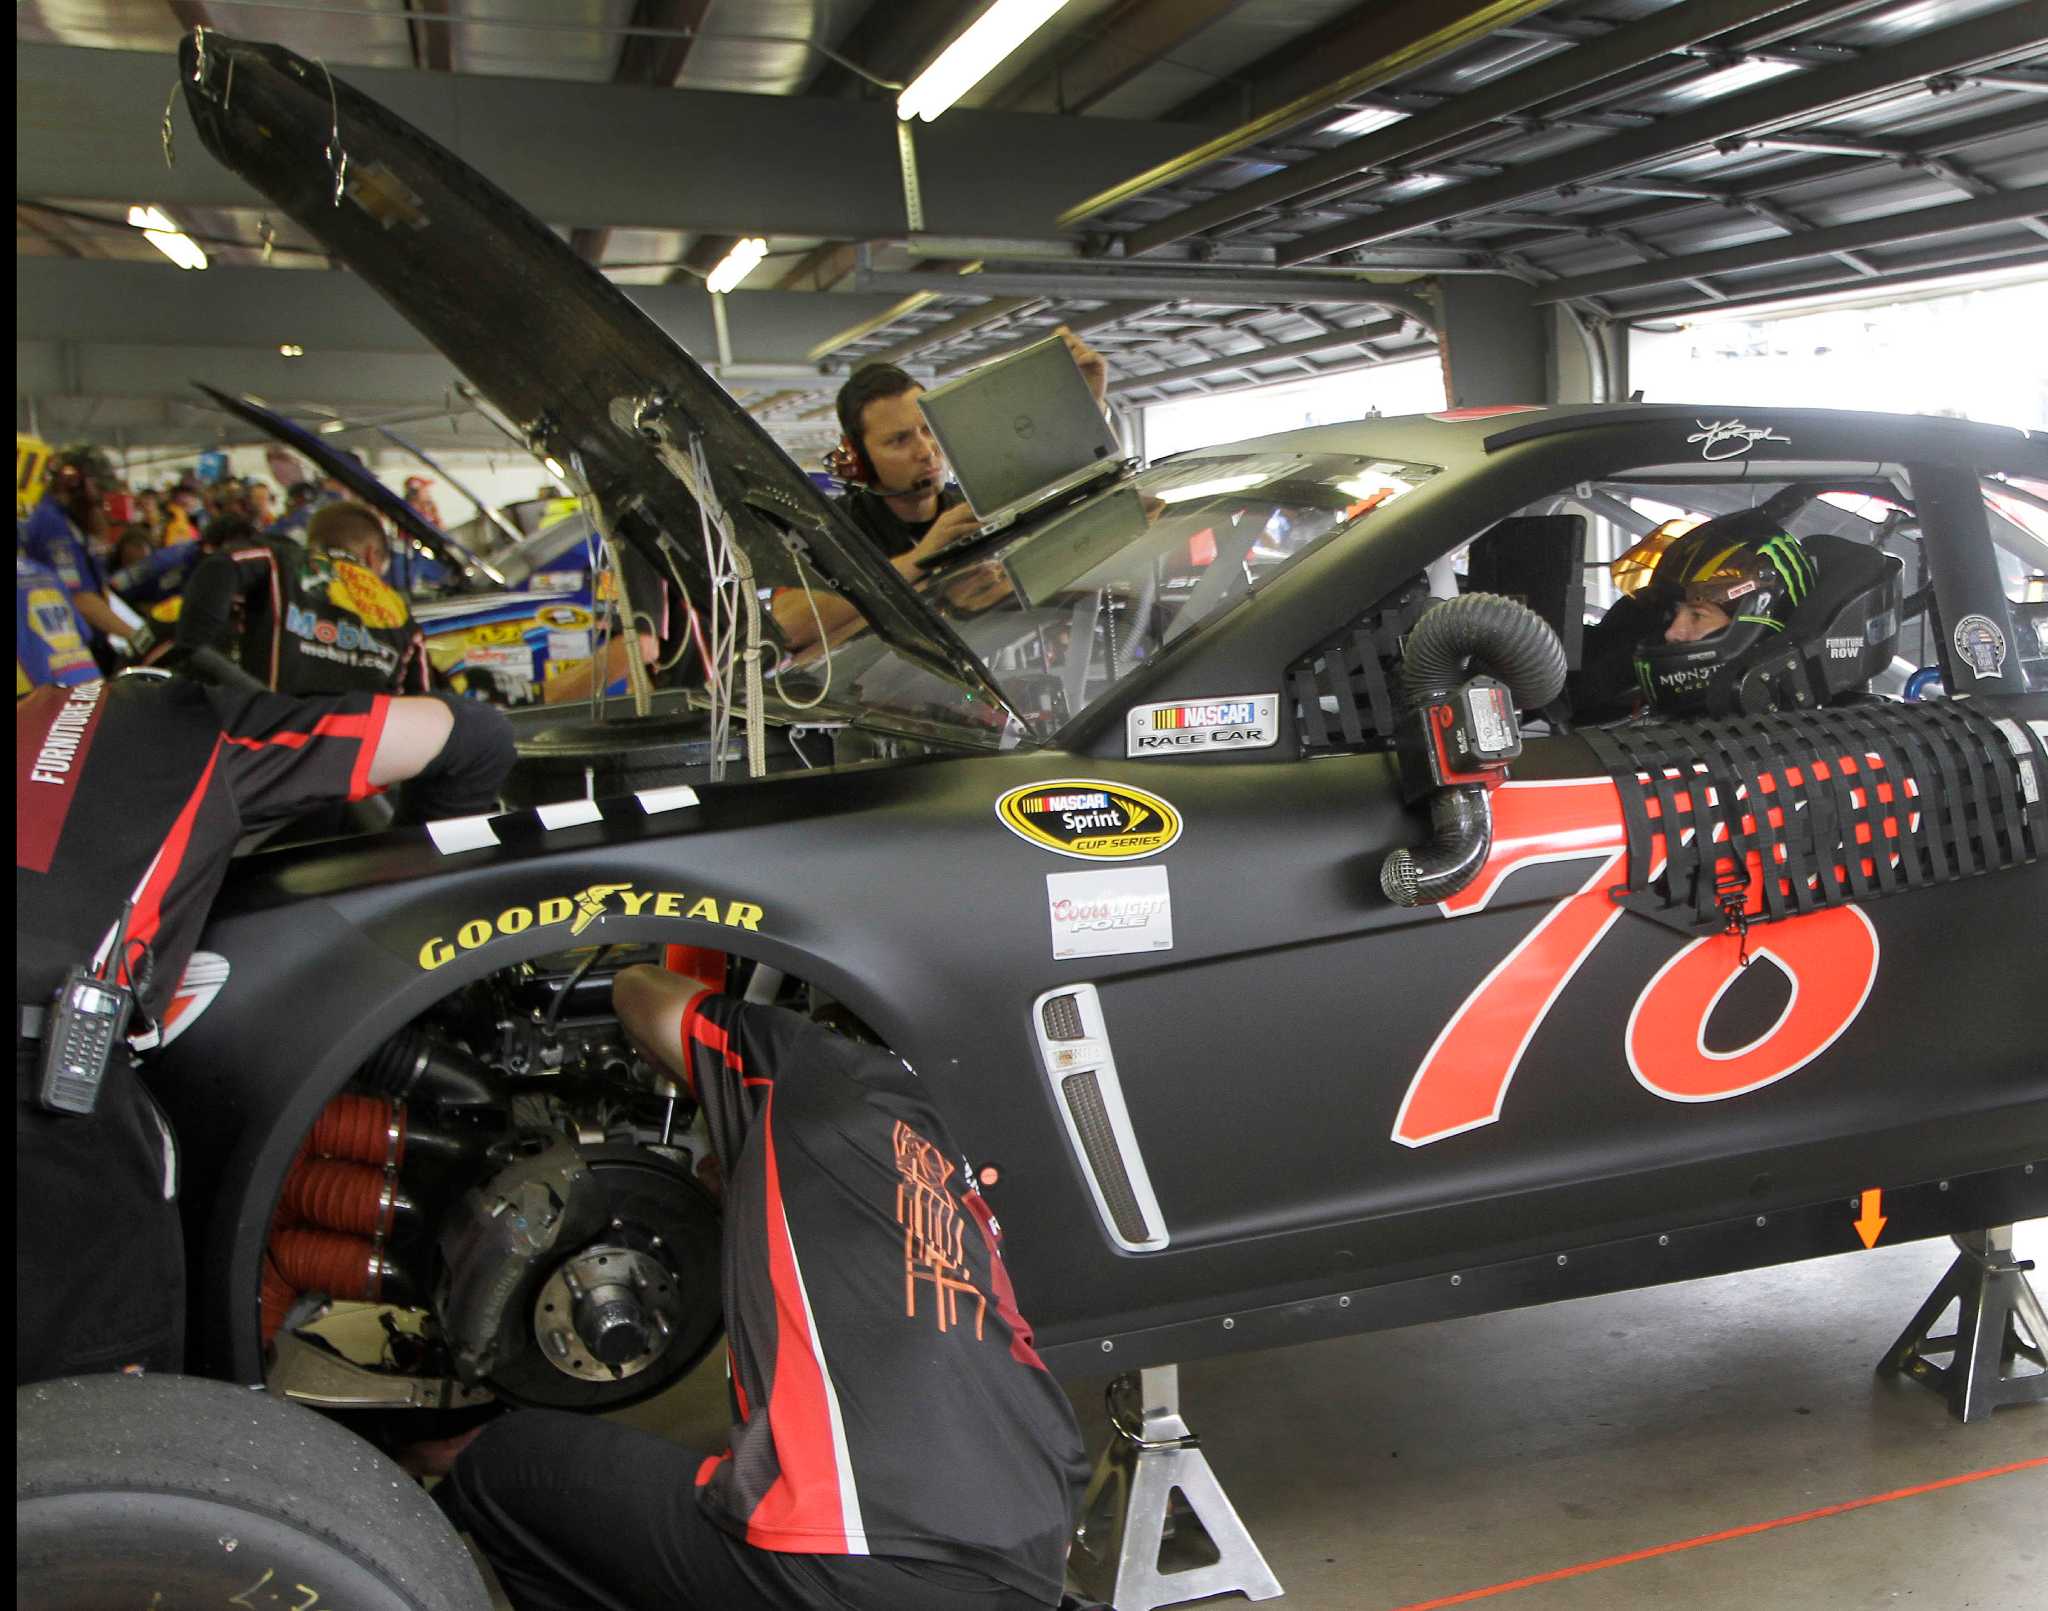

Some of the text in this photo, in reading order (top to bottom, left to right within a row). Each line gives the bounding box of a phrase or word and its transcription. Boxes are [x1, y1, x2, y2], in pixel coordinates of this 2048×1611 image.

[1826, 637, 1864, 649] FURNITURE
[1830, 647, 1859, 659] ROW
[1184, 703, 1250, 728] NASCAR
[31, 701, 97, 785] FURNITURE
[1138, 730, 1263, 748] RACE CAR
[1049, 793, 1106, 812] NASCAR
[1062, 810, 1123, 833] Sprint
[1077, 836, 1161, 851] CUP SERIES
[1053, 896, 1167, 921] Coors LIGHT
[1070, 914, 1151, 933] POLE
